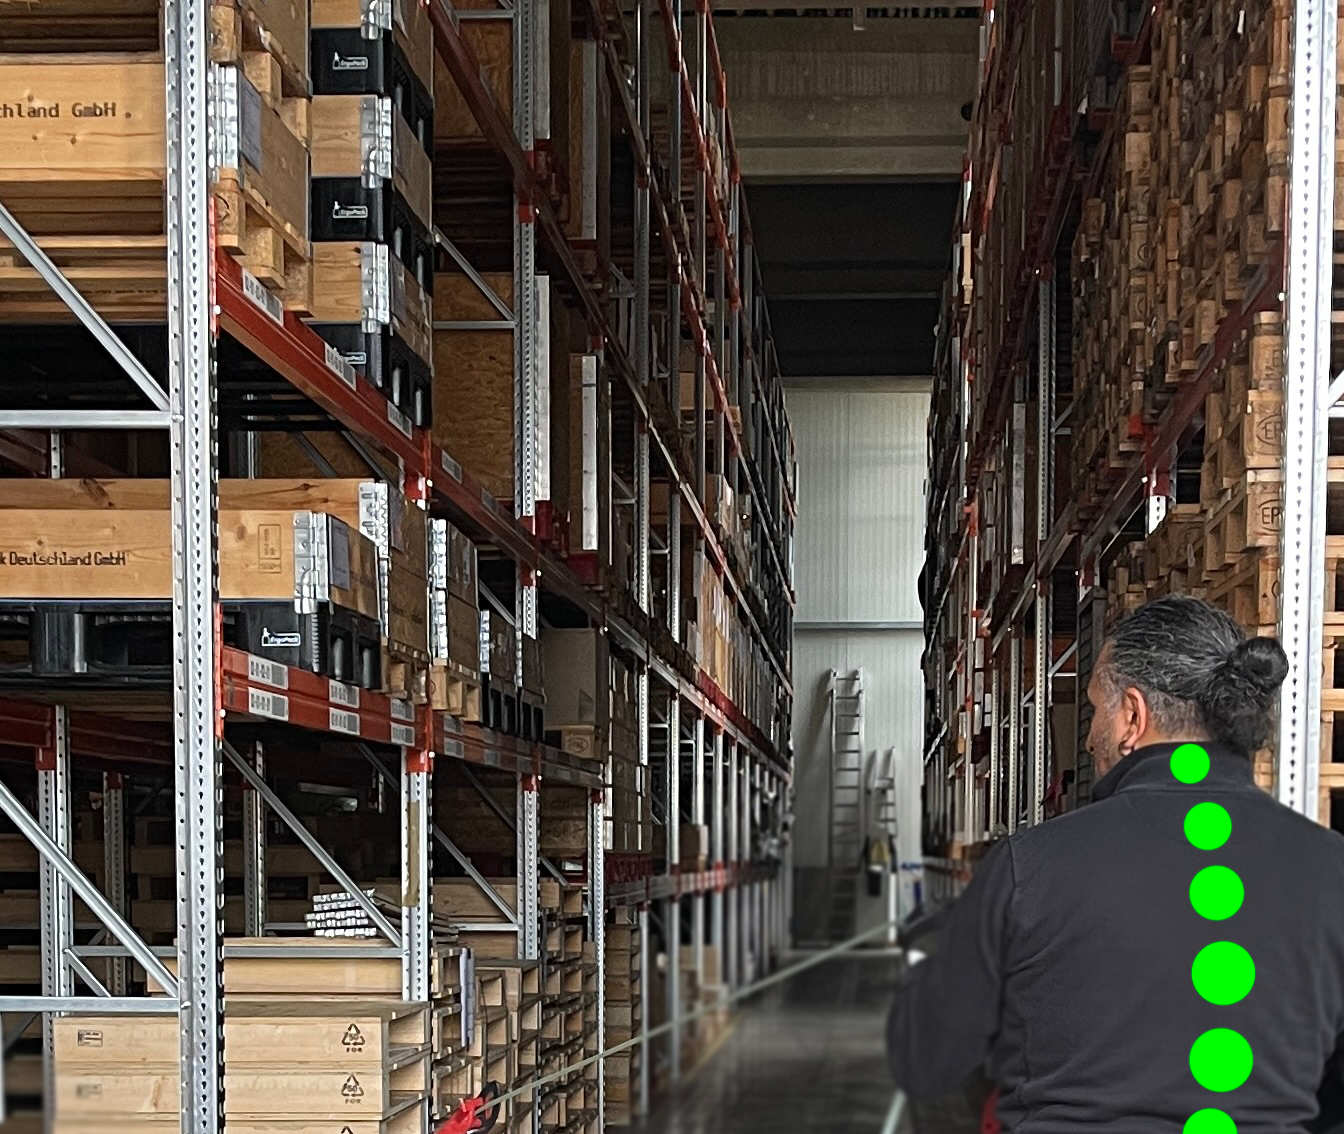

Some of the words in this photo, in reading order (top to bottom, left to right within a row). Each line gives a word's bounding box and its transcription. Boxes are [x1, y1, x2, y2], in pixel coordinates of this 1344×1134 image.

[71, 102, 117, 118] GmbH
[9, 551, 91, 566] Deutschland
[94, 551, 127, 566] GmbH
